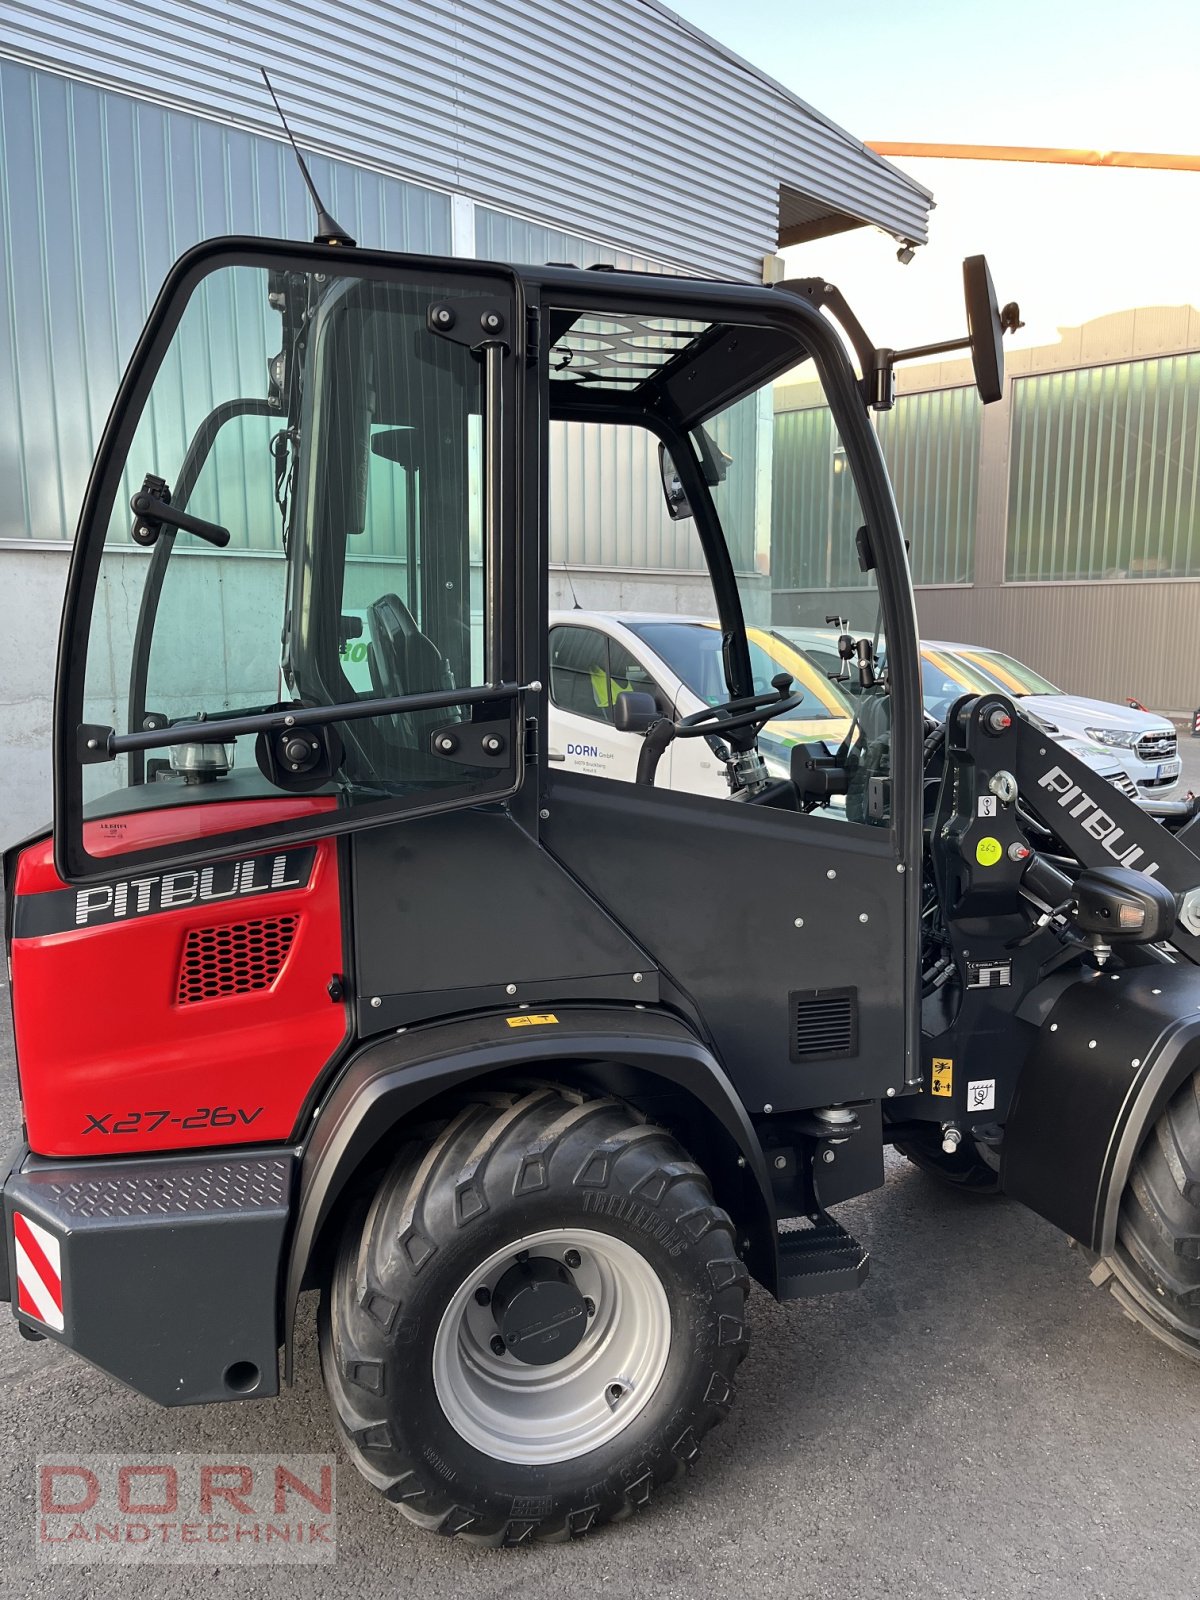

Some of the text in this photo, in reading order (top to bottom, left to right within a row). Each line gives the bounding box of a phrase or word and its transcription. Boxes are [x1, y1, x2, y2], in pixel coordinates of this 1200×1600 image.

[567, 744, 598, 757] DORN
[76, 855, 300, 924] PITBULL
[81, 1106, 264, 1135] X27-26V
[582, 1190, 688, 1256] TRELLEBORG
